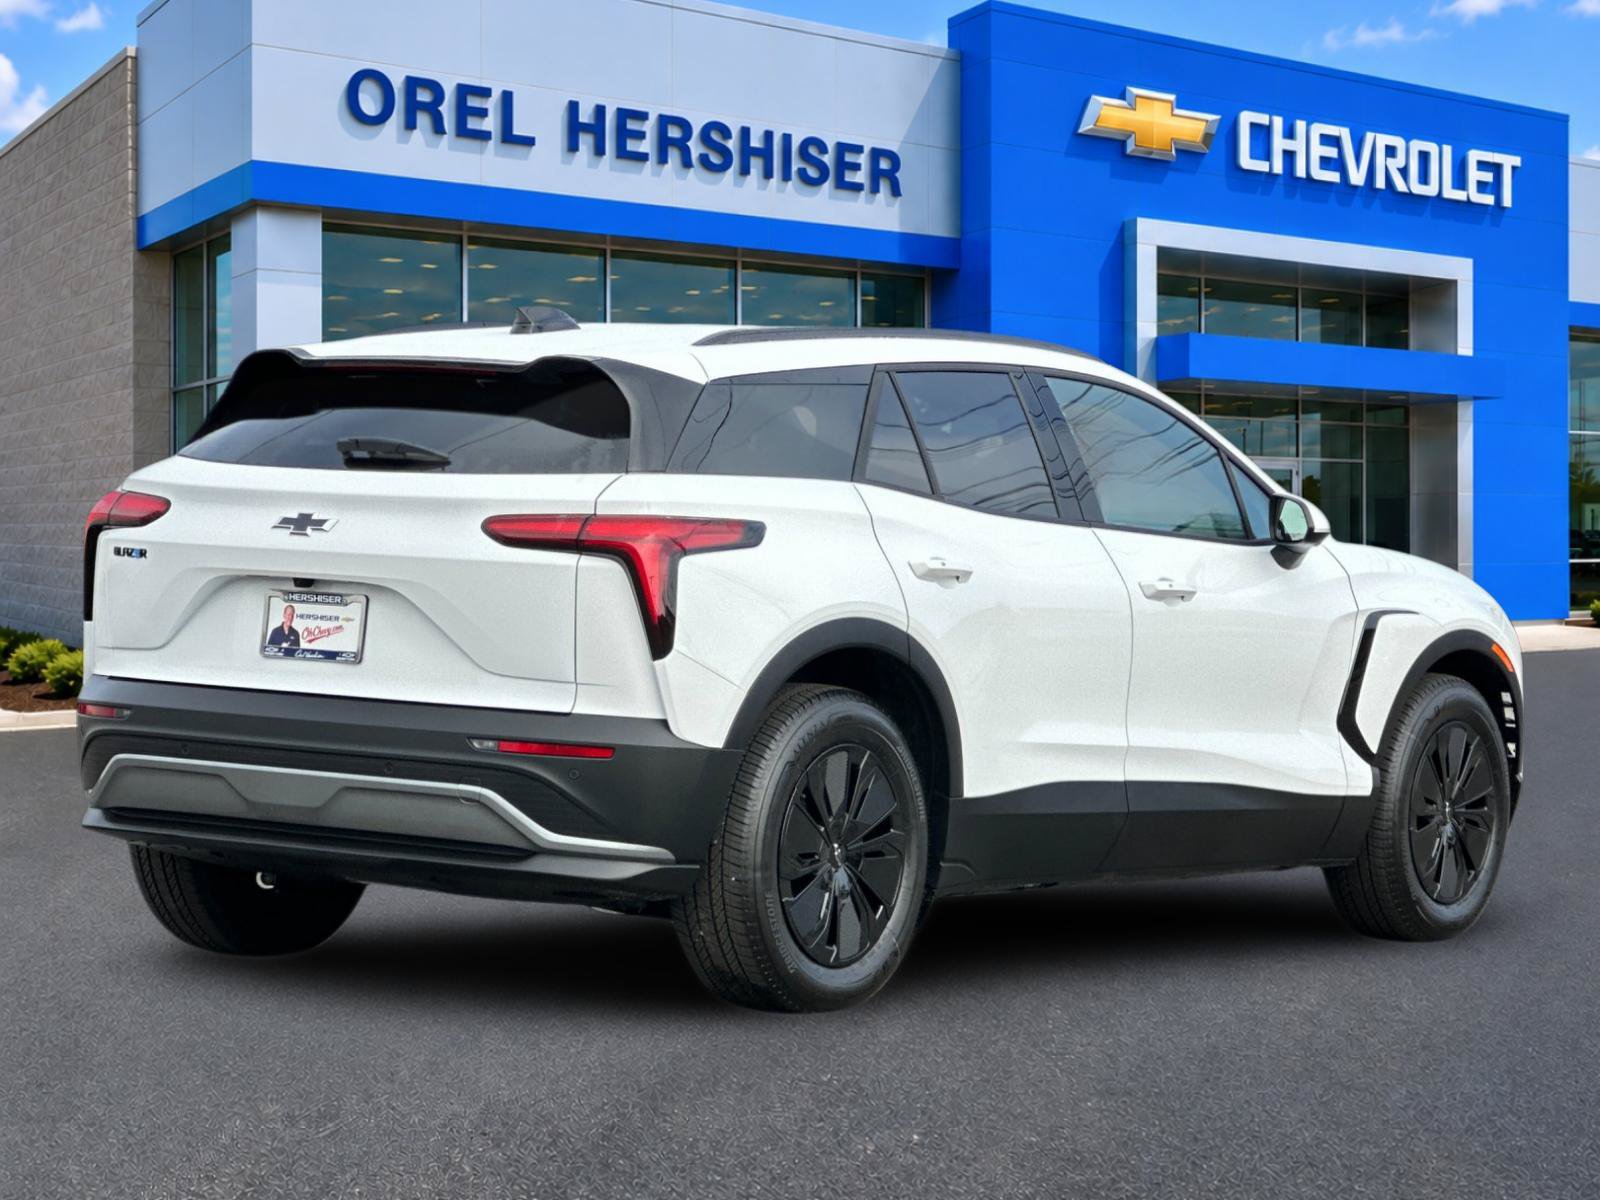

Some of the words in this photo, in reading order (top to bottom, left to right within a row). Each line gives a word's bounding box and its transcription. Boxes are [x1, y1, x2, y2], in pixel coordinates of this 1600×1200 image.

[346, 68, 535, 147] OREL
[567, 100, 902, 197] HERSHISER
[1236, 110, 1521, 208] CHEVROLET
[289, 593, 342, 603] HERSHISER
[296, 613, 340, 622] HERSHISER
